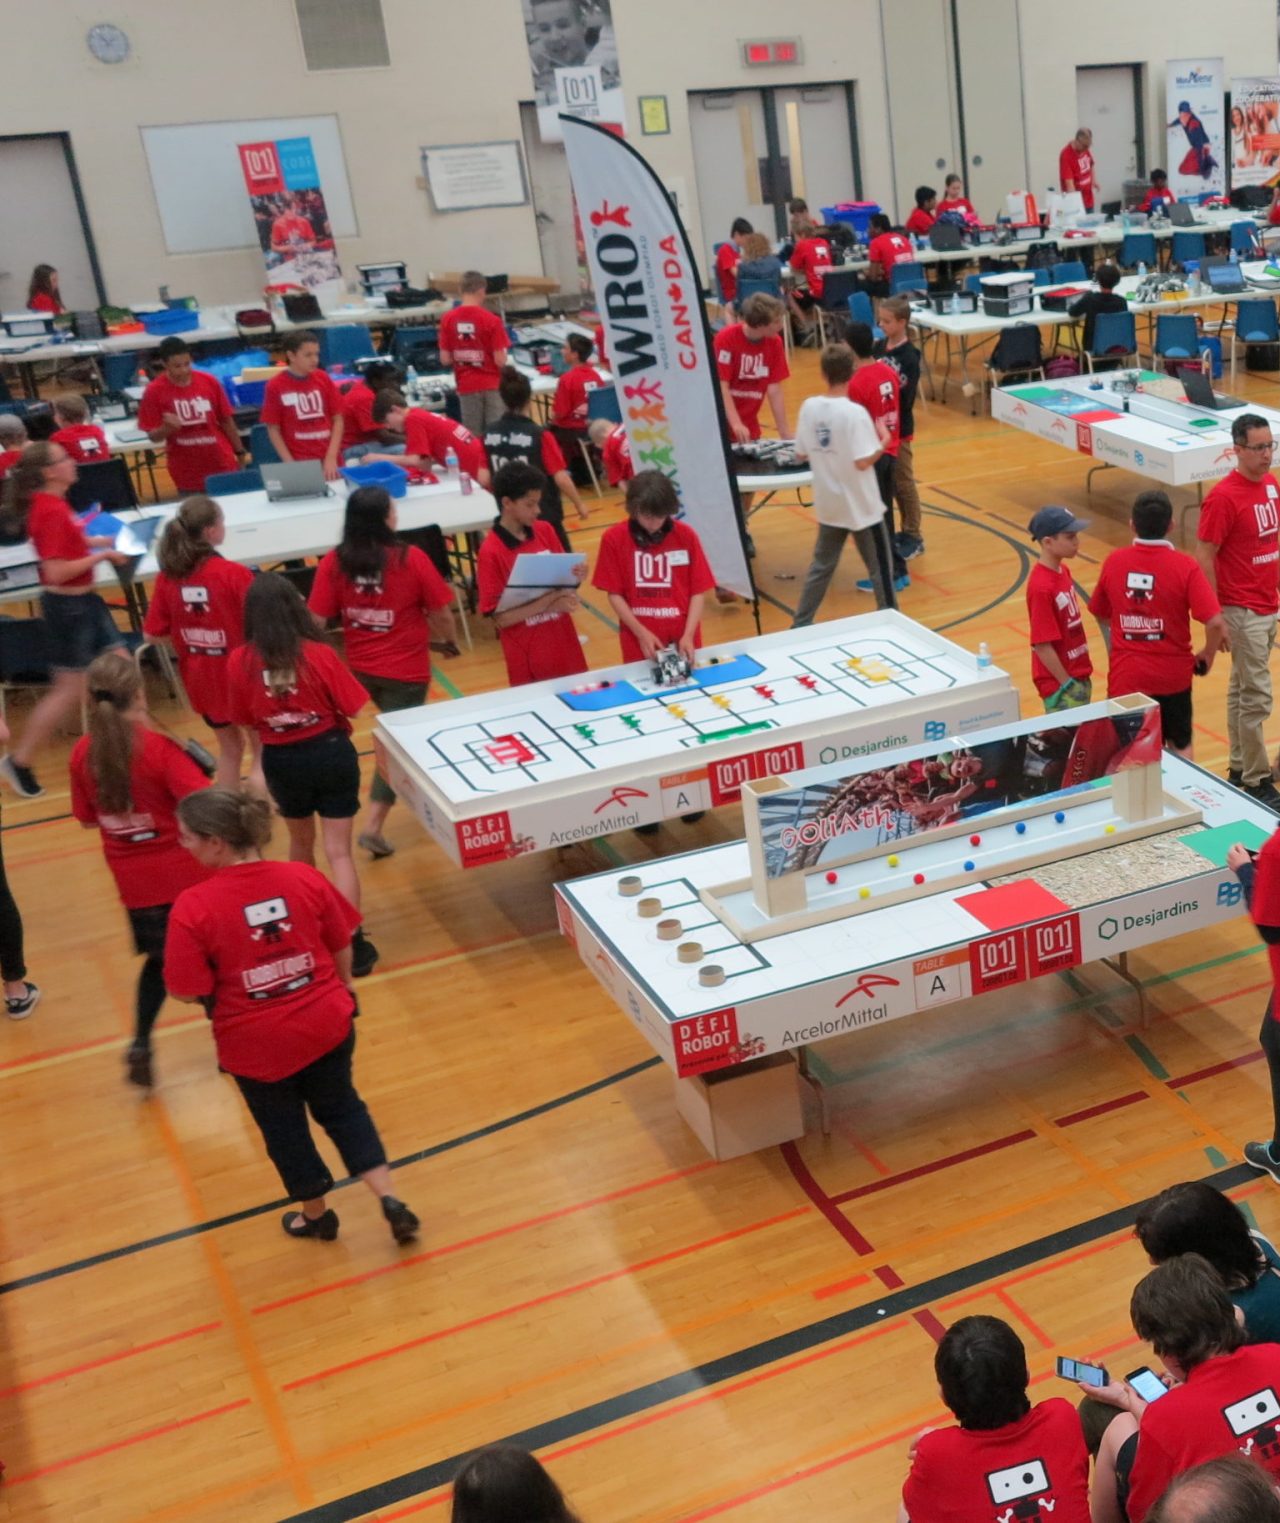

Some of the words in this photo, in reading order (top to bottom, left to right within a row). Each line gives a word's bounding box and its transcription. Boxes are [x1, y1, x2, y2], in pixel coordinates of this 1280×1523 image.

[596, 233, 657, 377] WRO
[634, 551, 672, 583] [01]
[842, 733, 908, 758] Desjardins
[717, 759, 749, 790] [01]
[764, 748, 797, 776] [01]
[676, 791, 690, 808] A
[462, 814, 505, 838] DÉFI
[464, 830, 506, 850] ROBOT
[549, 812, 640, 846] ArcelorMittal
[1124, 899, 1199, 932] Desjardins
[1036, 920, 1072, 957] [01]
[915, 956, 945, 972] TABLE
[979, 936, 1016, 973] [01]
[930, 975, 946, 995] A
[680, 1015, 729, 1041] DÉFI
[781, 1004, 888, 1047] ArcelorMittal
[682, 1029, 731, 1056] ROBOT
